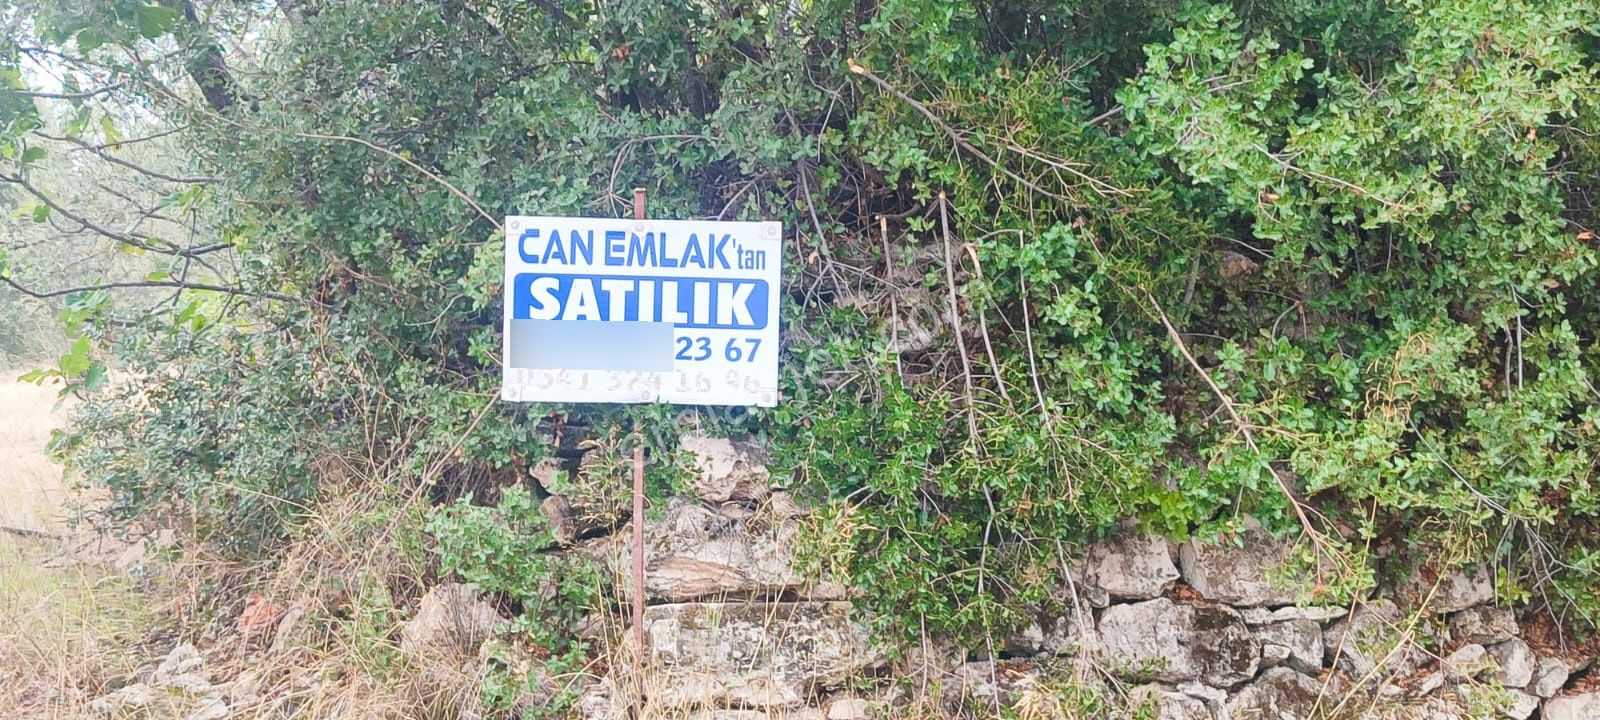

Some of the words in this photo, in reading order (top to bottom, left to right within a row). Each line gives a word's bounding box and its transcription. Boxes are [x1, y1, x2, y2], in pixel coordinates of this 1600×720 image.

[518, 228, 595, 266] CAN
[604, 230, 767, 271] EMLAK'tan
[528, 276, 756, 326] SATILIK
[675, 336, 713, 361] 23
[724, 338, 762, 362] 67
